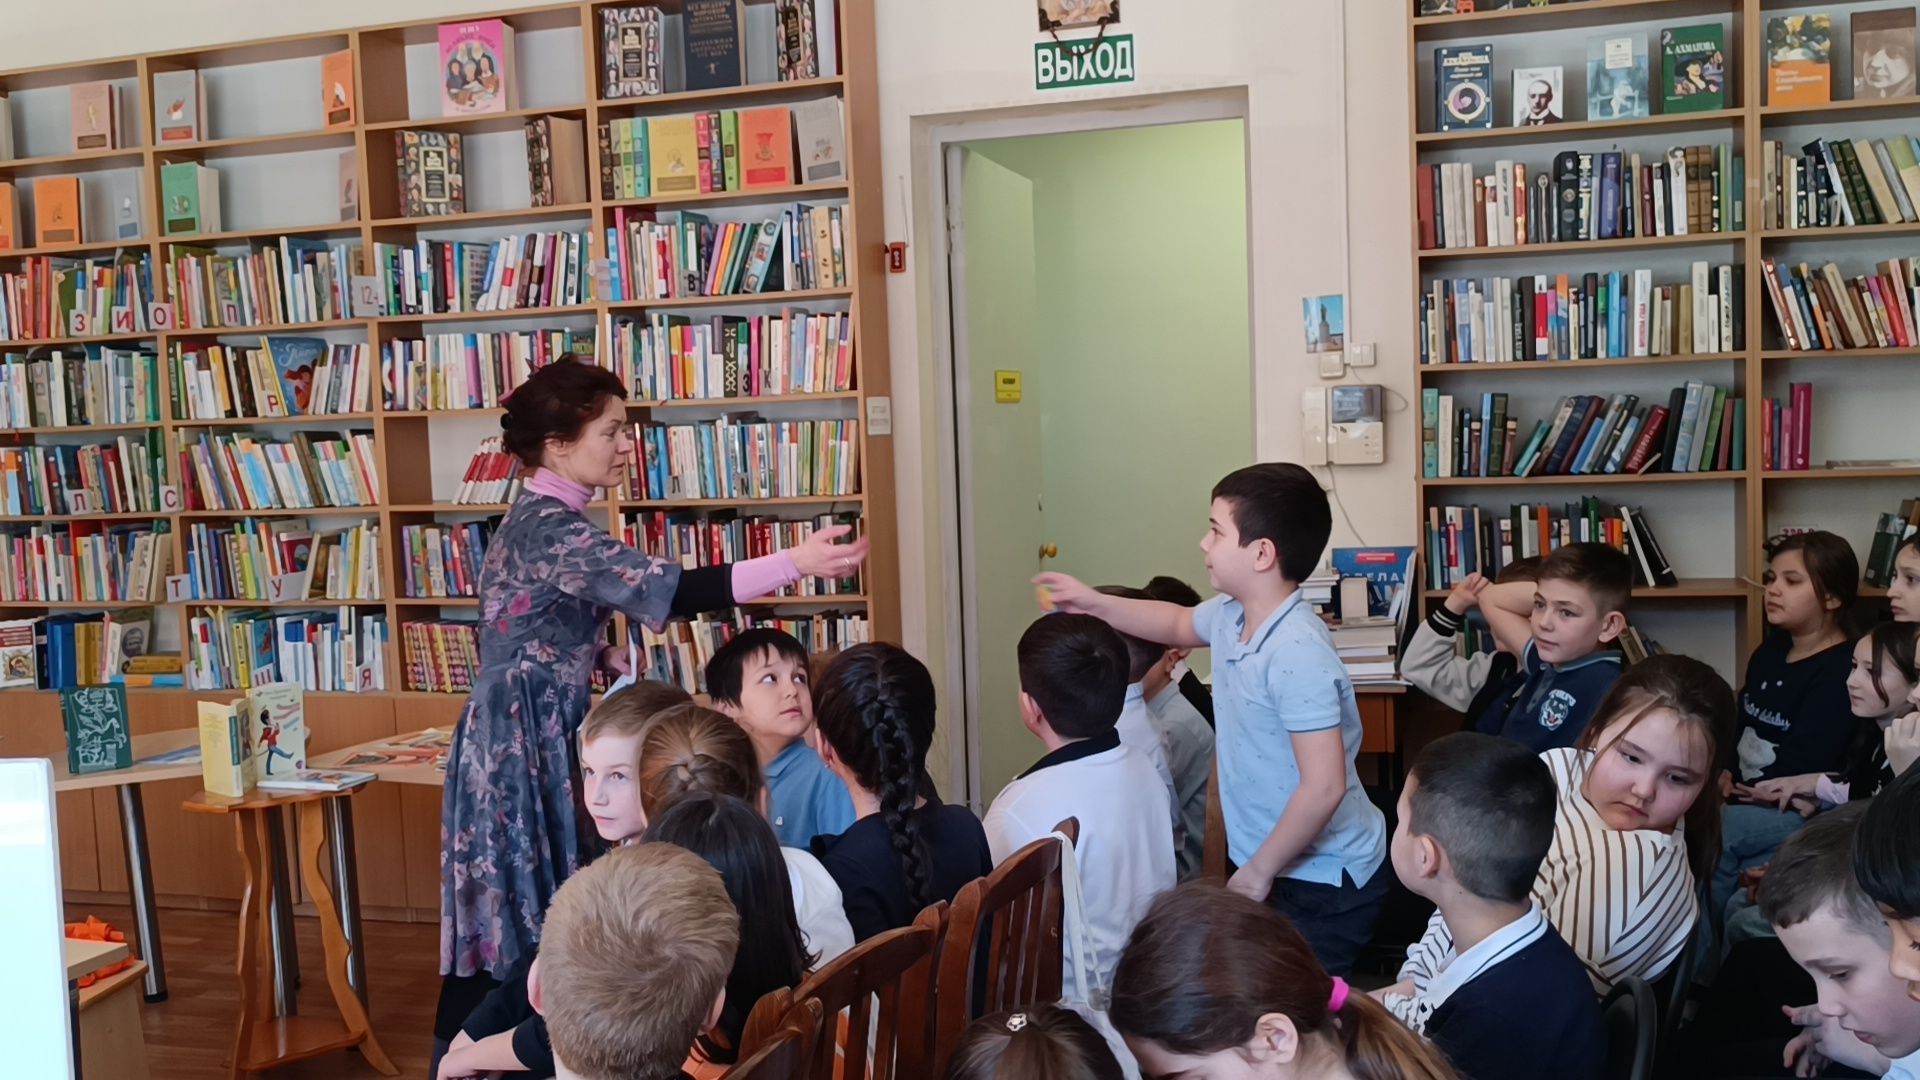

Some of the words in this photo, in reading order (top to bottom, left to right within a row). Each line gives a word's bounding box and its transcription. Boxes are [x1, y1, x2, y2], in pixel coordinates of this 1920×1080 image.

[1037, 40, 1134, 84] ВЫХОД
[226, 304, 238, 322] П
[267, 394, 278, 412] Р
[74, 493, 86, 511] Л
[171, 579, 181, 597] Т
[362, 668, 372, 688] Я
